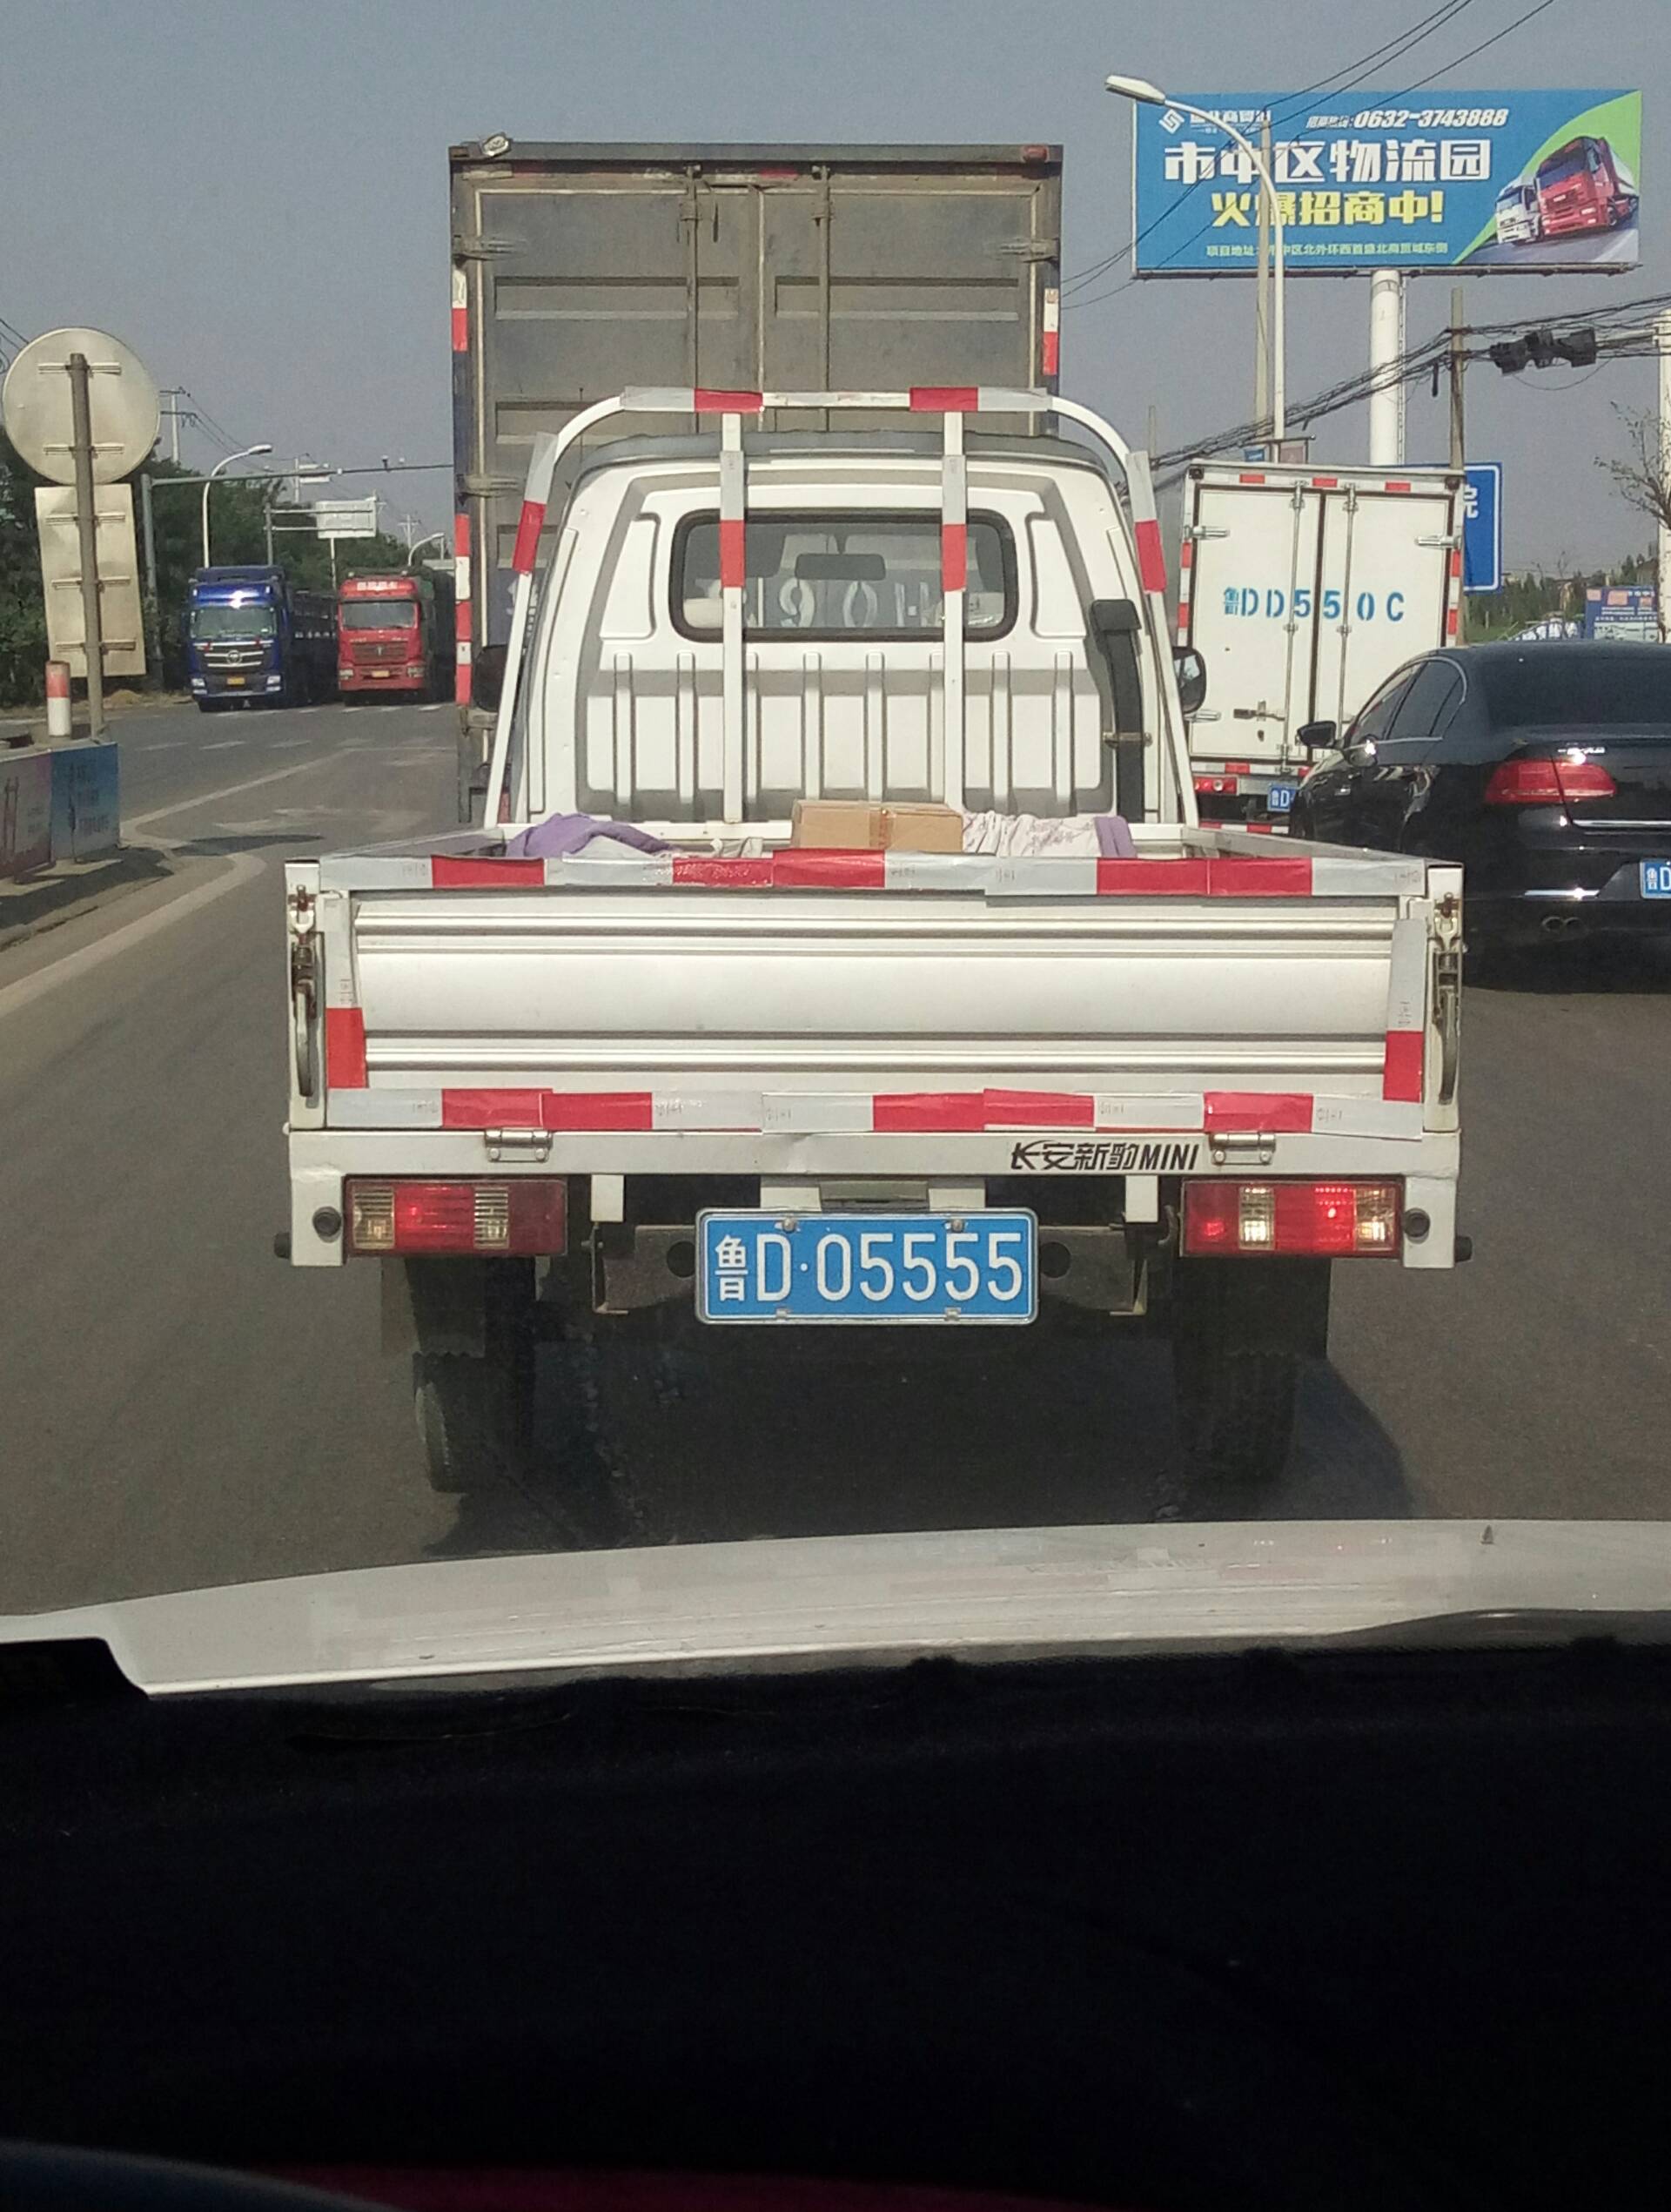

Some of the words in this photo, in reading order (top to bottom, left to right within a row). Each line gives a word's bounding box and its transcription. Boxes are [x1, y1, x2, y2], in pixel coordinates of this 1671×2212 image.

[1353, 108, 1509, 129] 0632-3743888
[1164, 139, 1491, 185] 市中区物流园
[1223, 587, 1405, 622] 鲁DD550C
[715, 1233, 1023, 1301] 鲁D·05555
